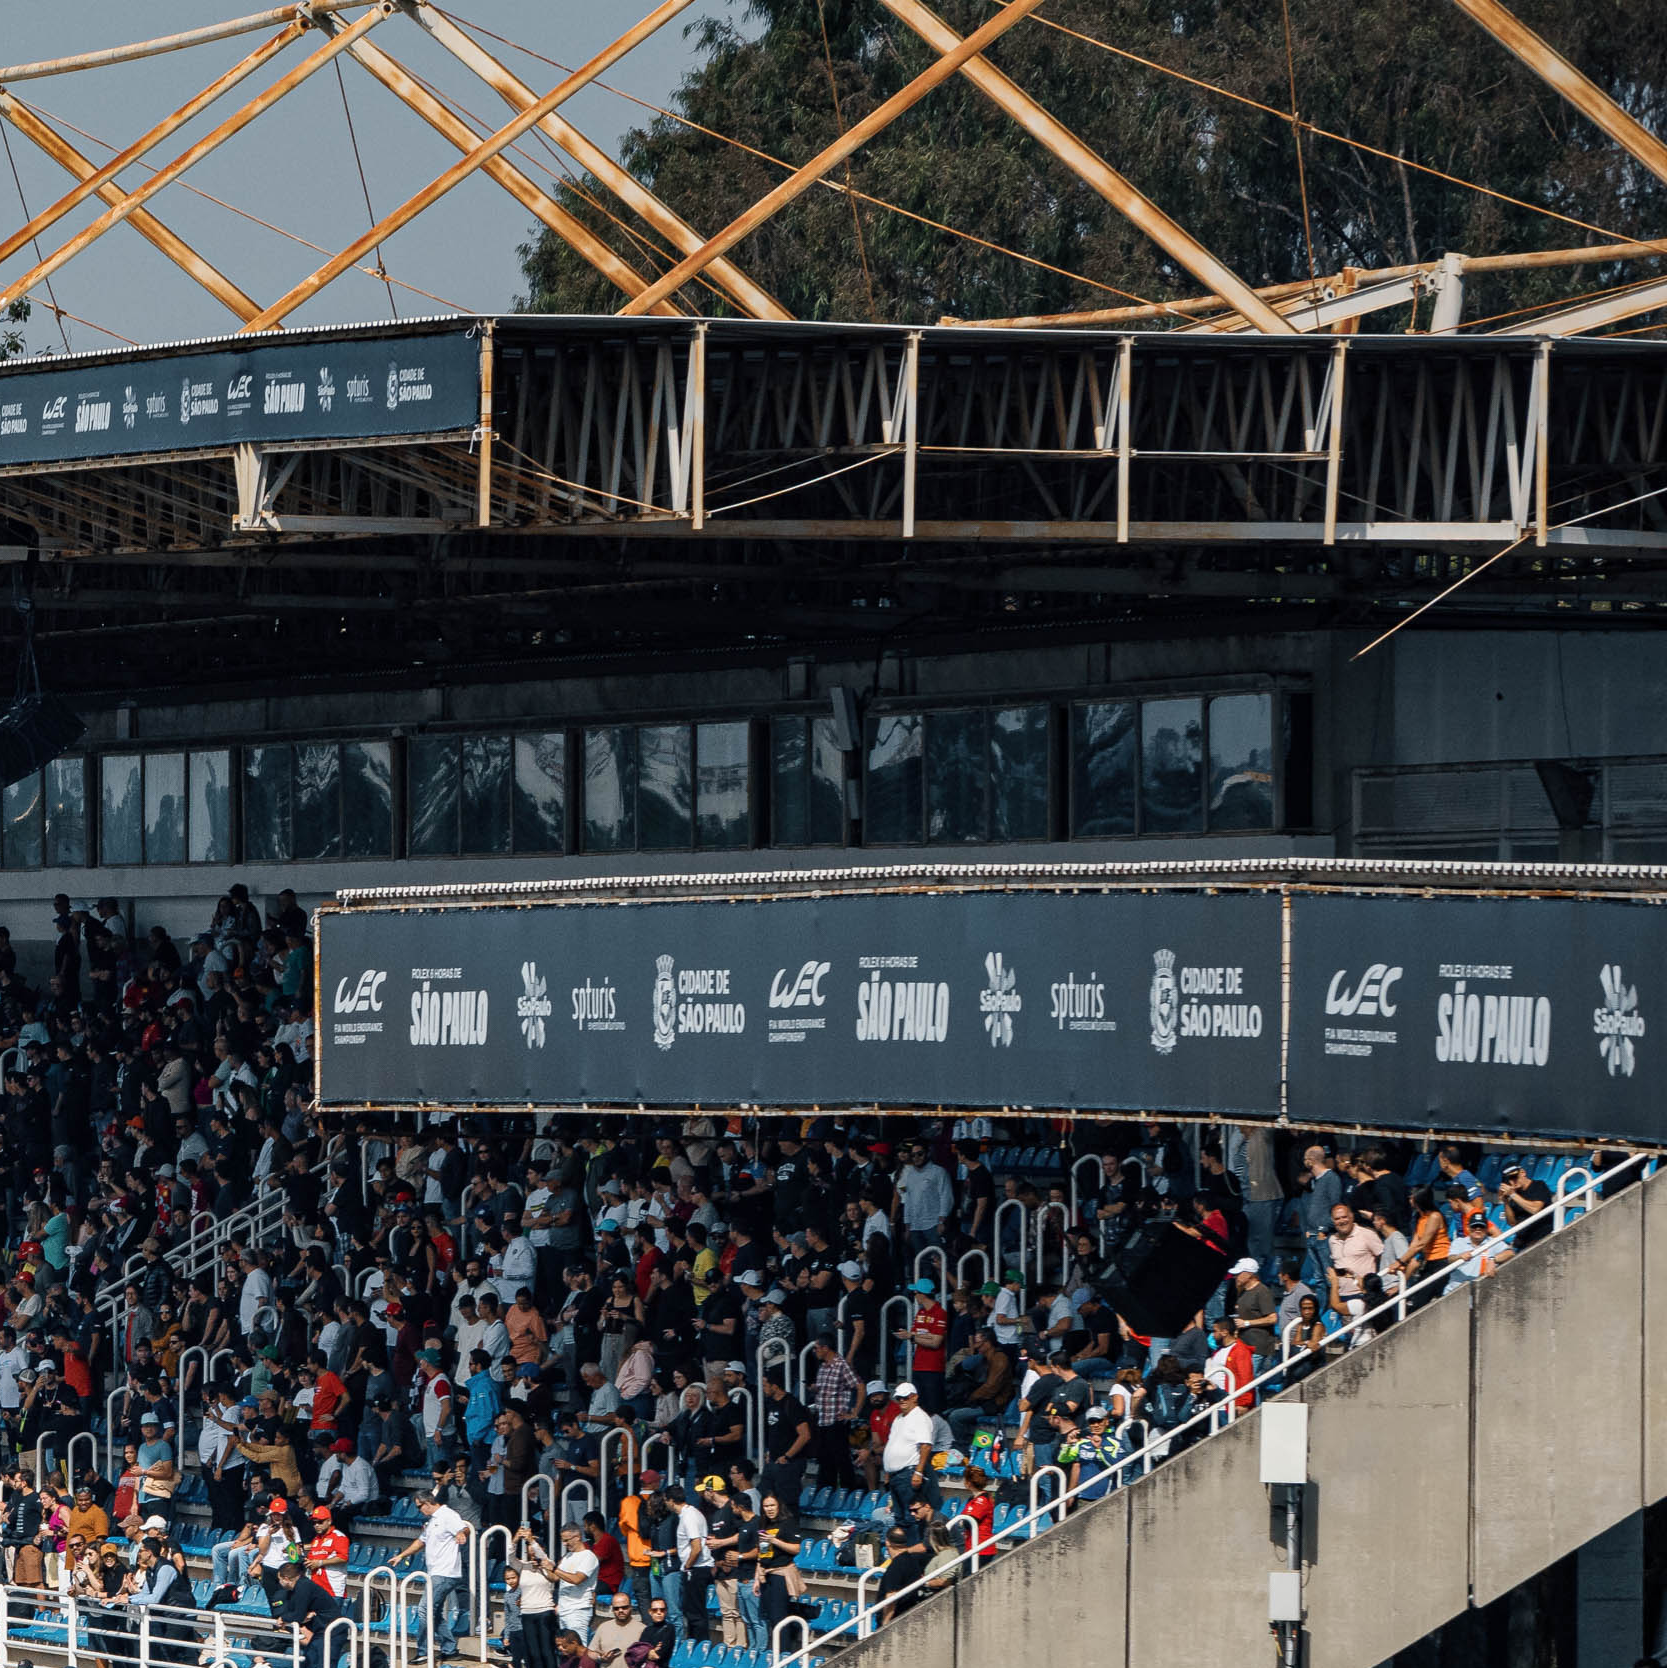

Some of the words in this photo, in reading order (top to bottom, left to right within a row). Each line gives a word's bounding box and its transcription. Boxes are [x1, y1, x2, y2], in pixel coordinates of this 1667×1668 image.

[227, 375, 253, 399] WEC
[264, 380, 279, 414] SÃO
[279, 382, 306, 412] PAULO
[334, 969, 387, 1014] WEC
[678, 970, 714, 994] CIDADE
[715, 970, 730, 994] DE
[768, 960, 831, 1008] WEC
[1051, 972, 1105, 1030] spturis
[1181, 967, 1224, 994] CIDADE
[1225, 967, 1243, 994] DE
[1325, 963, 1403, 1017] WEC
[410, 981, 440, 1046] SÃO
[441, 990, 489, 1046] PAULO
[572, 977, 616, 1031] spturis
[678, 997, 704, 1033] SÃO
[705, 1003, 745, 1033] PAULO
[856, 970, 892, 1041] SÃO
[892, 982, 949, 1042] PAULO
[1180, 997, 1212, 1036] SÃO
[1212, 1004, 1263, 1037] PAULO
[1436, 980, 1480, 1063] SÃO
[1481, 995, 1551, 1066] PAULO
[1593, 1007, 1645, 1036] SãoPaulo
